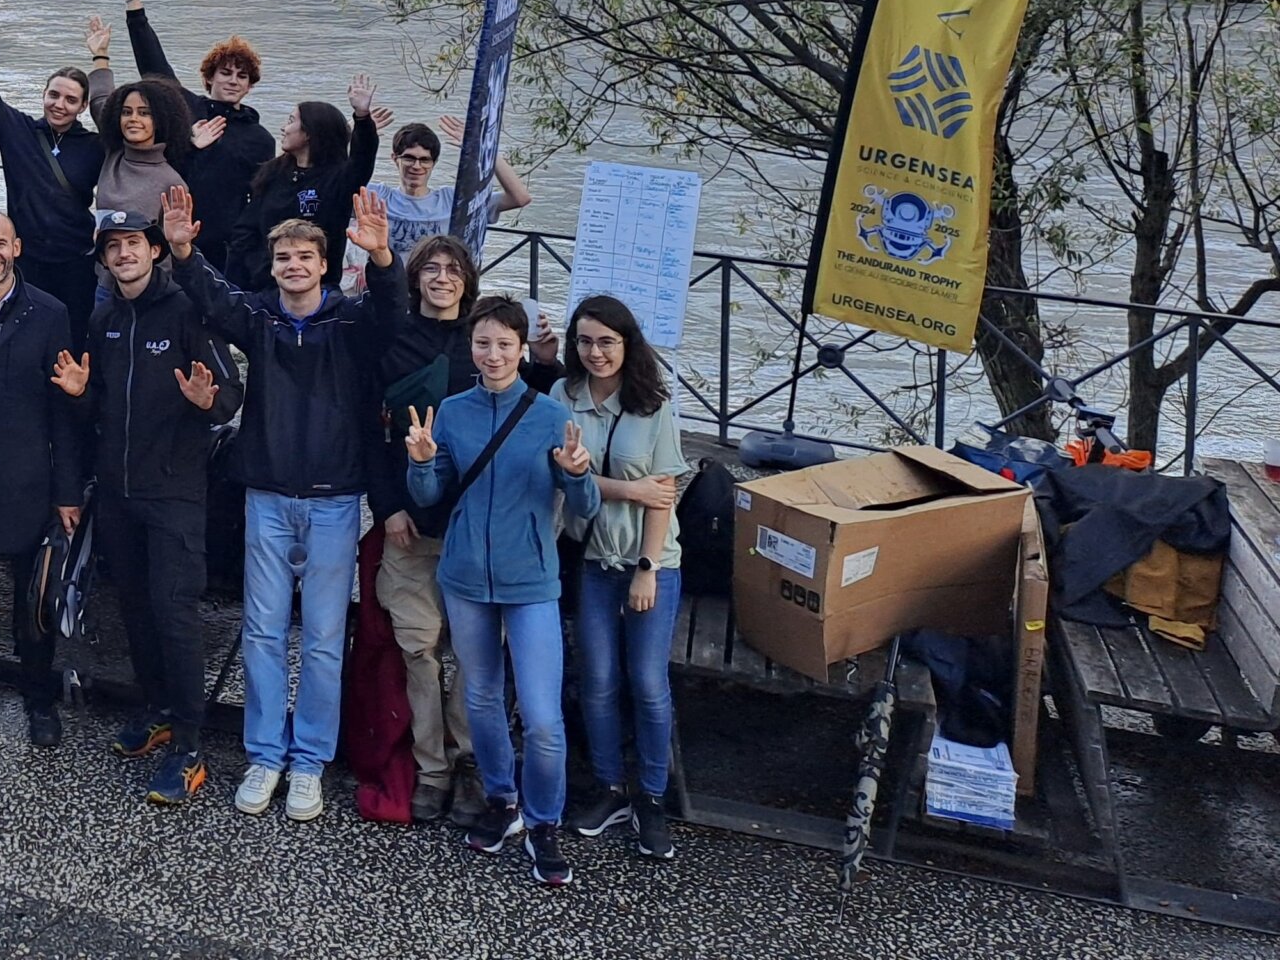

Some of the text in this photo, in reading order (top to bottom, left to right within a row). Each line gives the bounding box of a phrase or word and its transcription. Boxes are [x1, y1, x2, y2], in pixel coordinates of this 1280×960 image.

[858, 144, 976, 192] URGENSEA
[850, 201, 876, 216] 2024
[934, 222, 961, 238] 2025
[836, 249, 962, 290] THE ANDURAND TROPHY
[831, 293, 957, 336] URGENSEA.ORG
